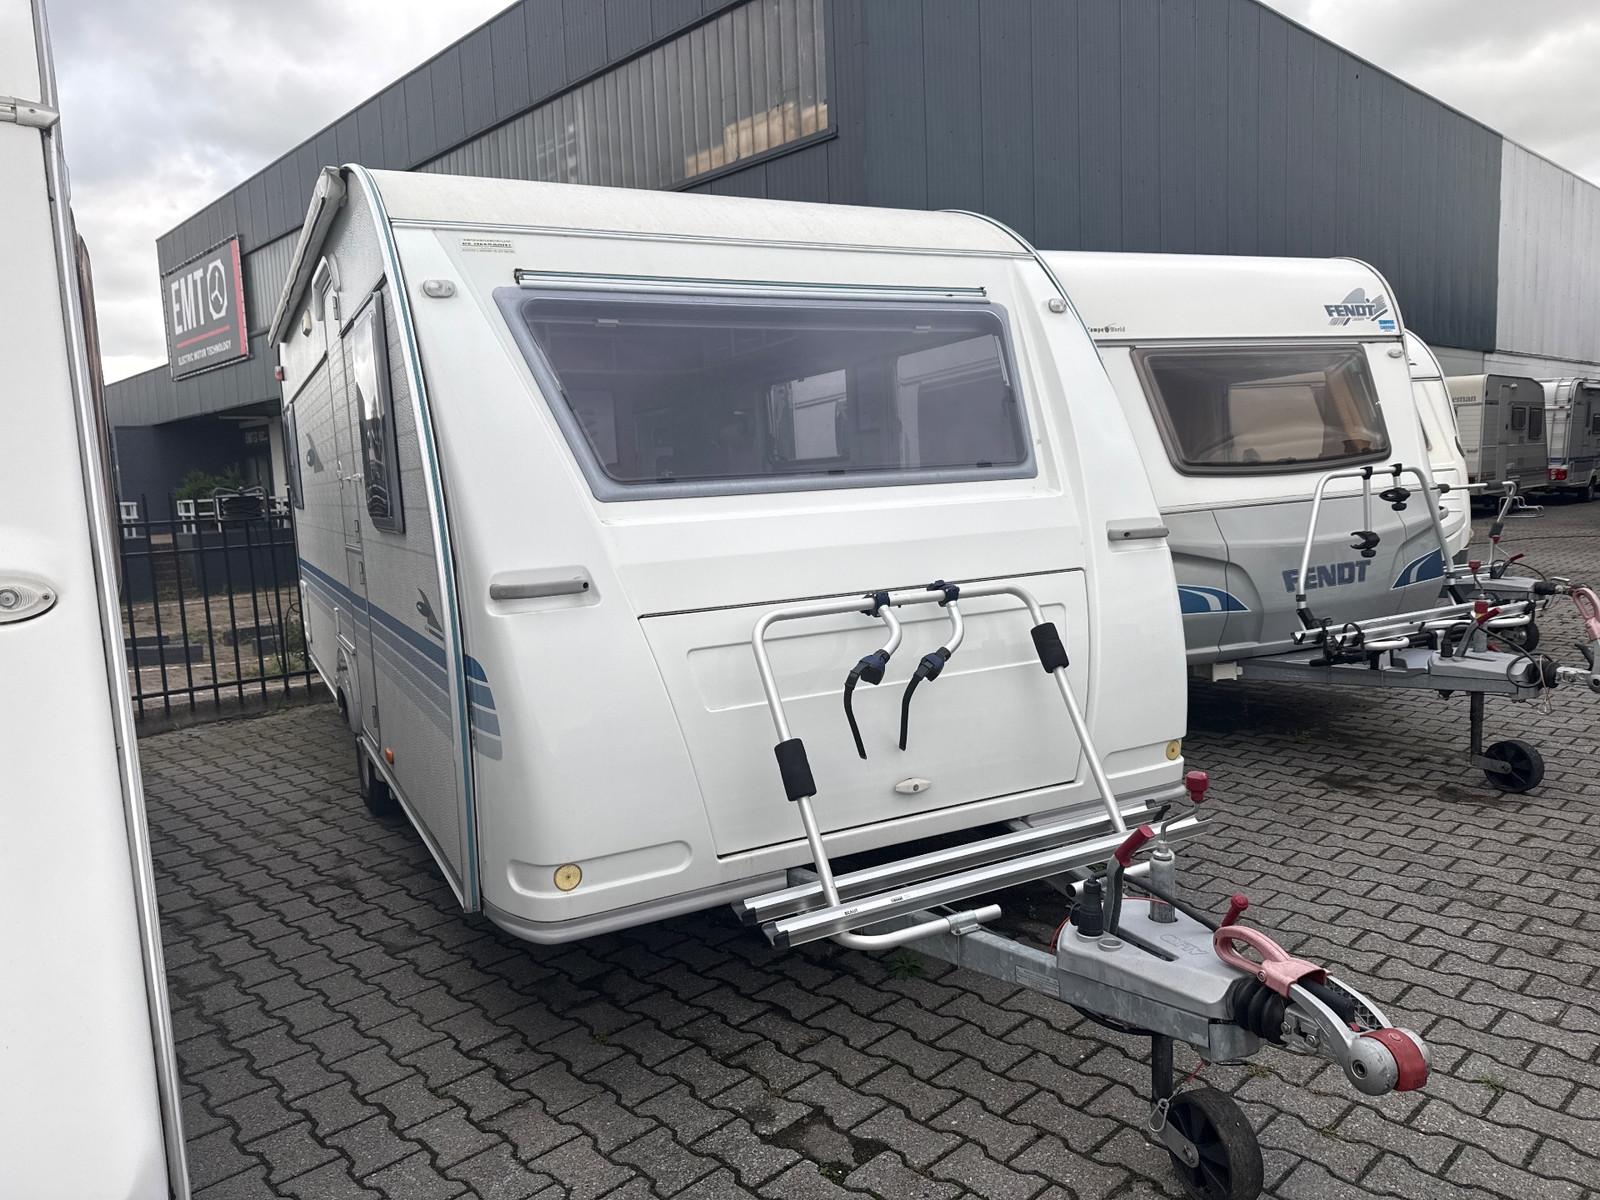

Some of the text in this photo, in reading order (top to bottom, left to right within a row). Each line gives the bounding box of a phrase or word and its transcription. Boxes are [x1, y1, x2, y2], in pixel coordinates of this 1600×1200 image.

[171, 268, 204, 335] EMT
[1324, 304, 1375, 318] FENDT
[193, 348, 207, 360] MOTOR
[206, 339, 231, 356] TECHNOLOGY
[1282, 559, 1371, 593] FENDT
